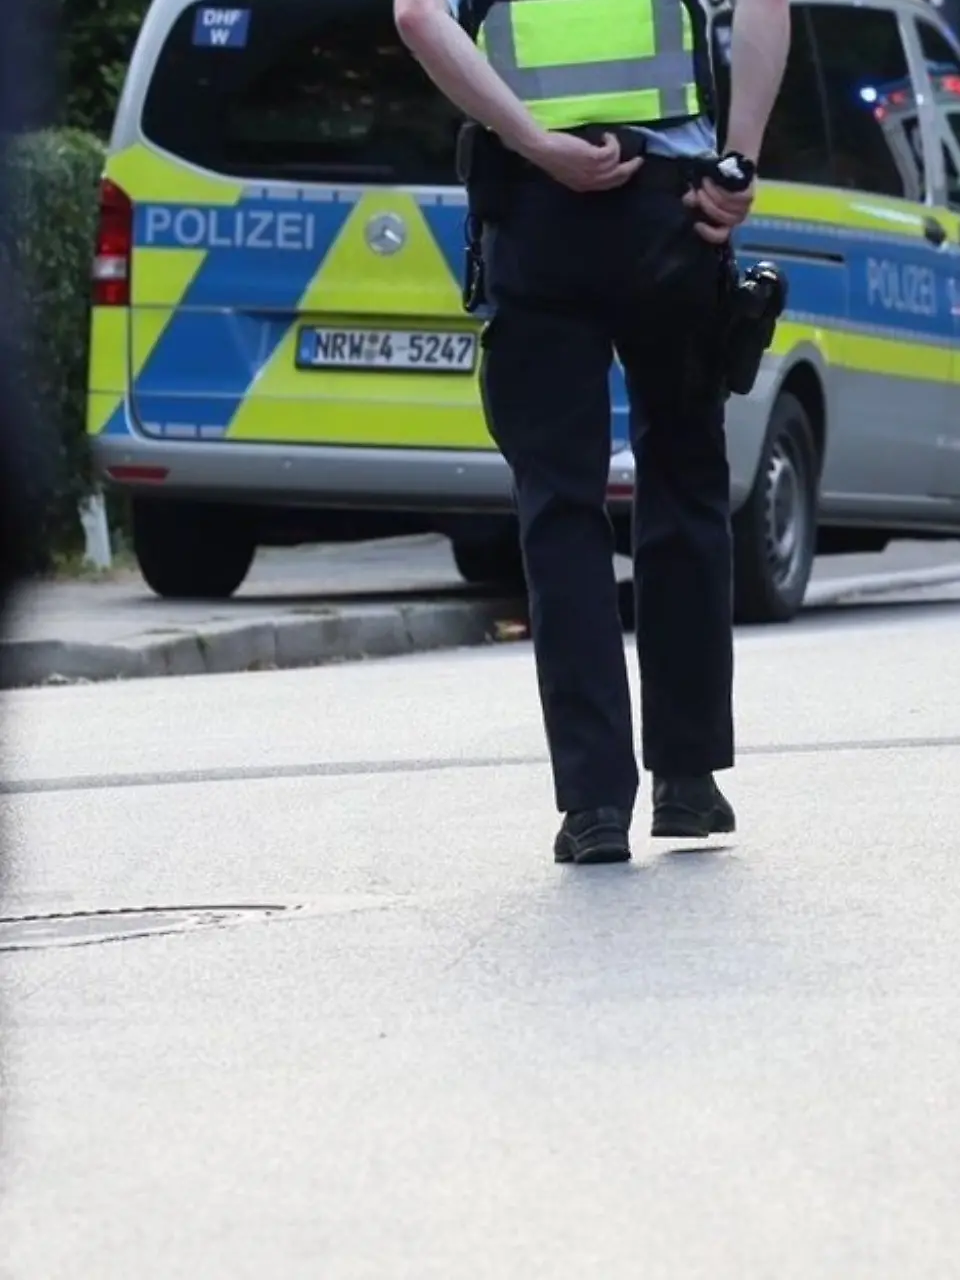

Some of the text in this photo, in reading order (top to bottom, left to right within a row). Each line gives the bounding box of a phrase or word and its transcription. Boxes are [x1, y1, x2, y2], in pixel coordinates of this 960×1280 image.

[210, 28, 230, 45] W
[145, 206, 315, 251] POLIZEI
[866, 257, 936, 316] POLIZEI
